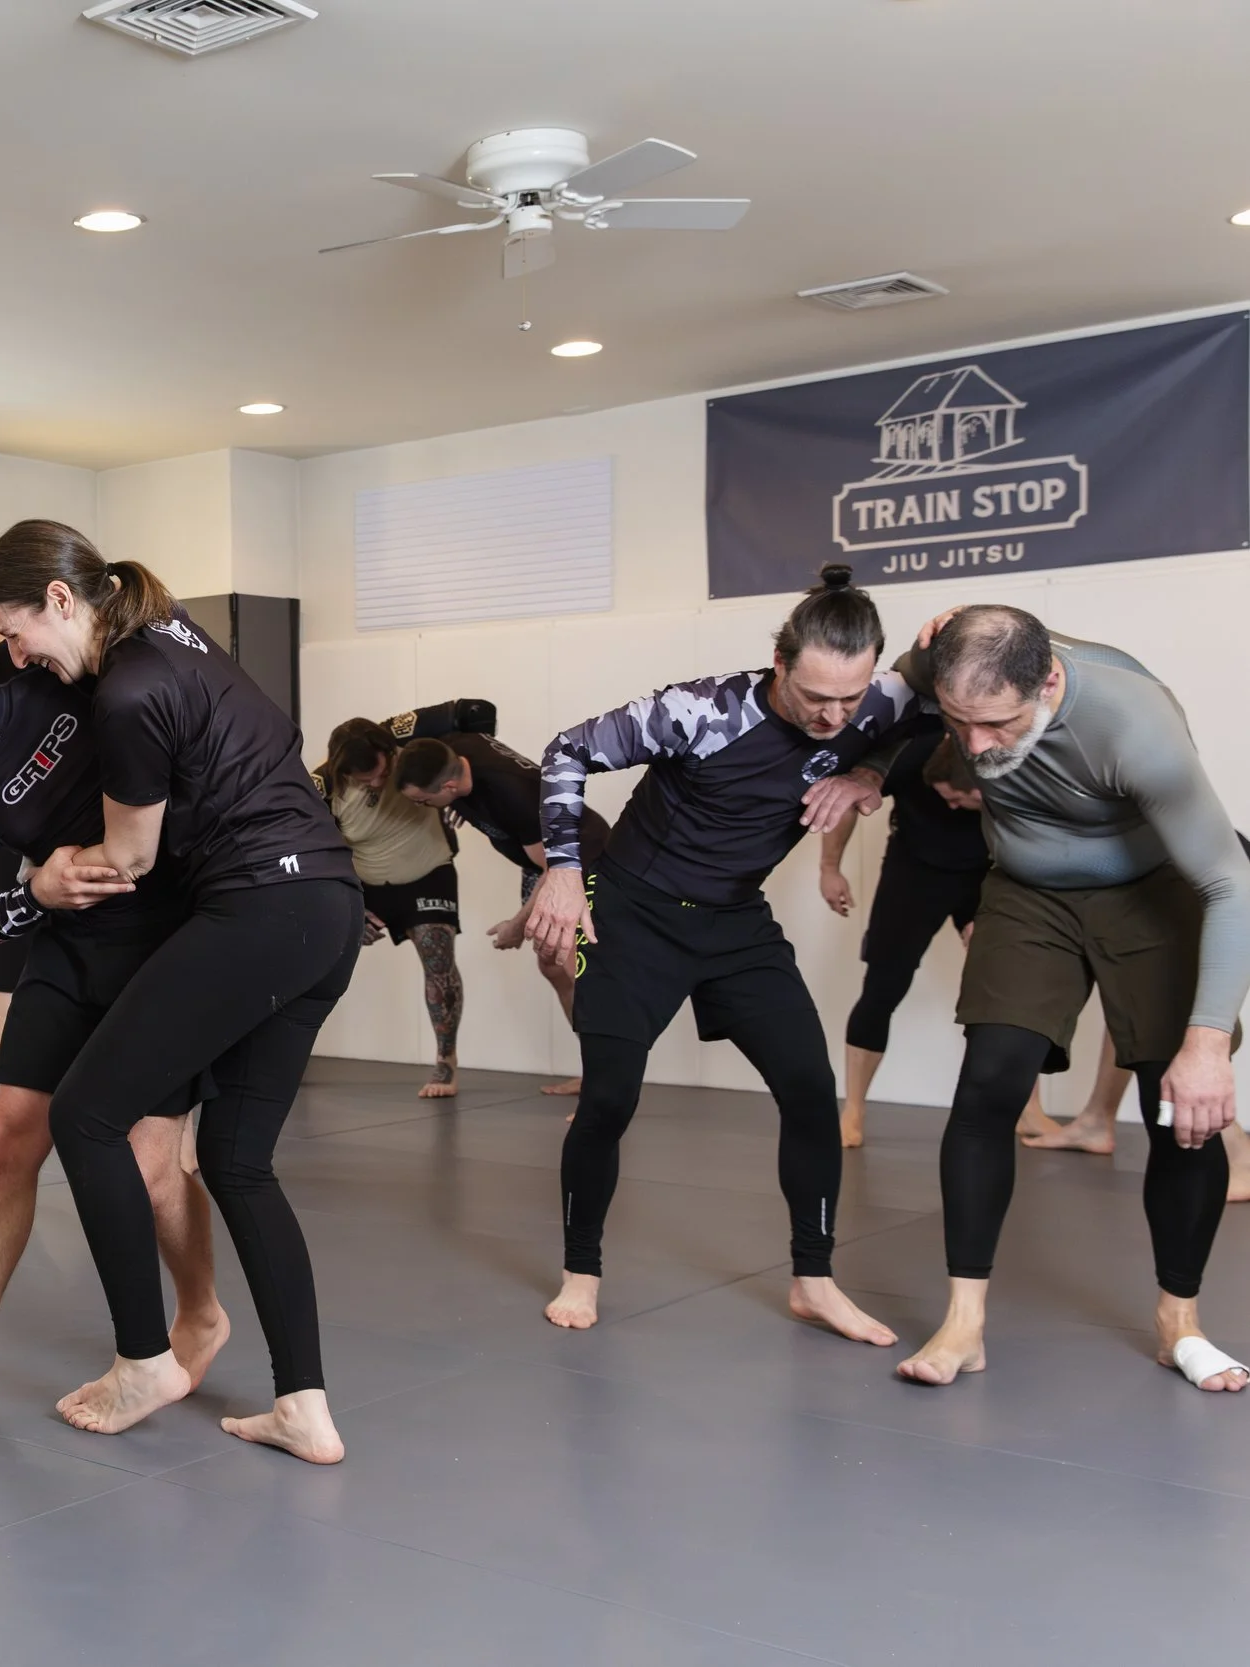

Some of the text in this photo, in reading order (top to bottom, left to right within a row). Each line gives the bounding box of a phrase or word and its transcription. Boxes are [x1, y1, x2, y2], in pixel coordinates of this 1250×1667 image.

[851, 478, 1067, 531] TRAIN STOP
[882, 542, 1025, 574] JIU JITSU
[2, 713, 78, 805] GRIPS
